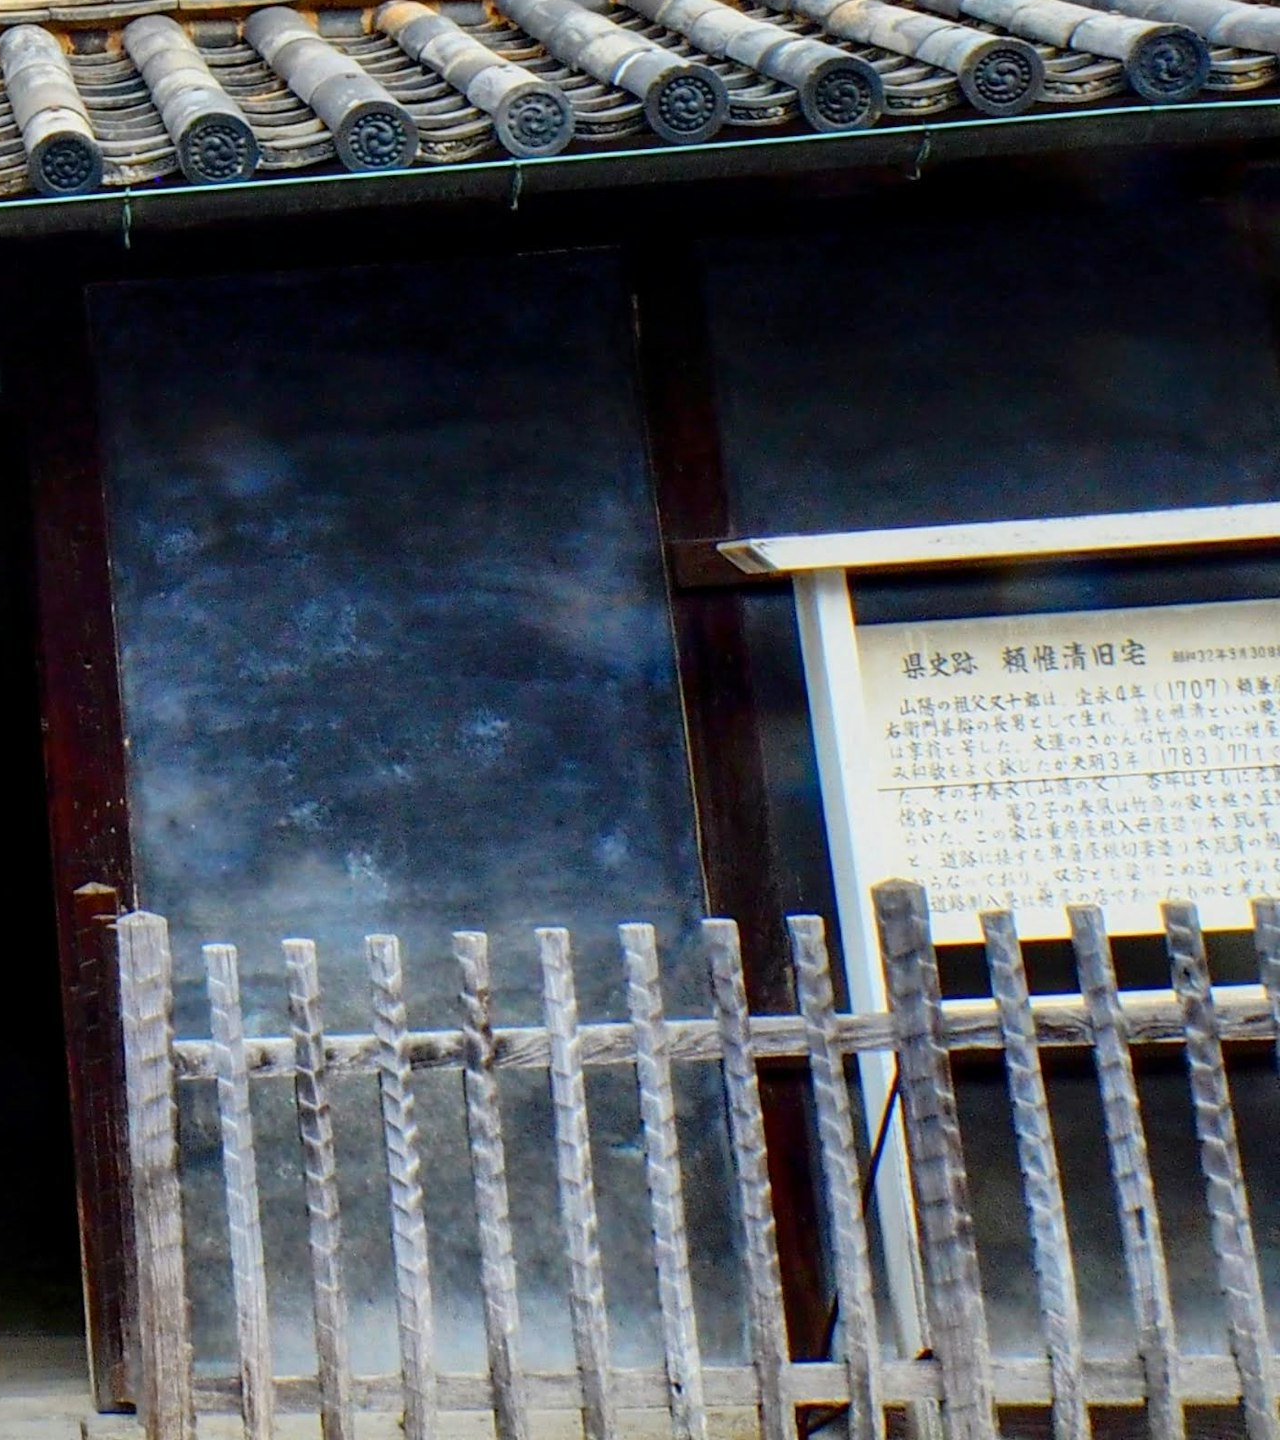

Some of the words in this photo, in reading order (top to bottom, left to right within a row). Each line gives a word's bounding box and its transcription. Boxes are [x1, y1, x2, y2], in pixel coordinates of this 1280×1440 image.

[901, 650, 979, 679] 県史跡
[1002, 638, 1146, 674] 頼惟清旧宅
